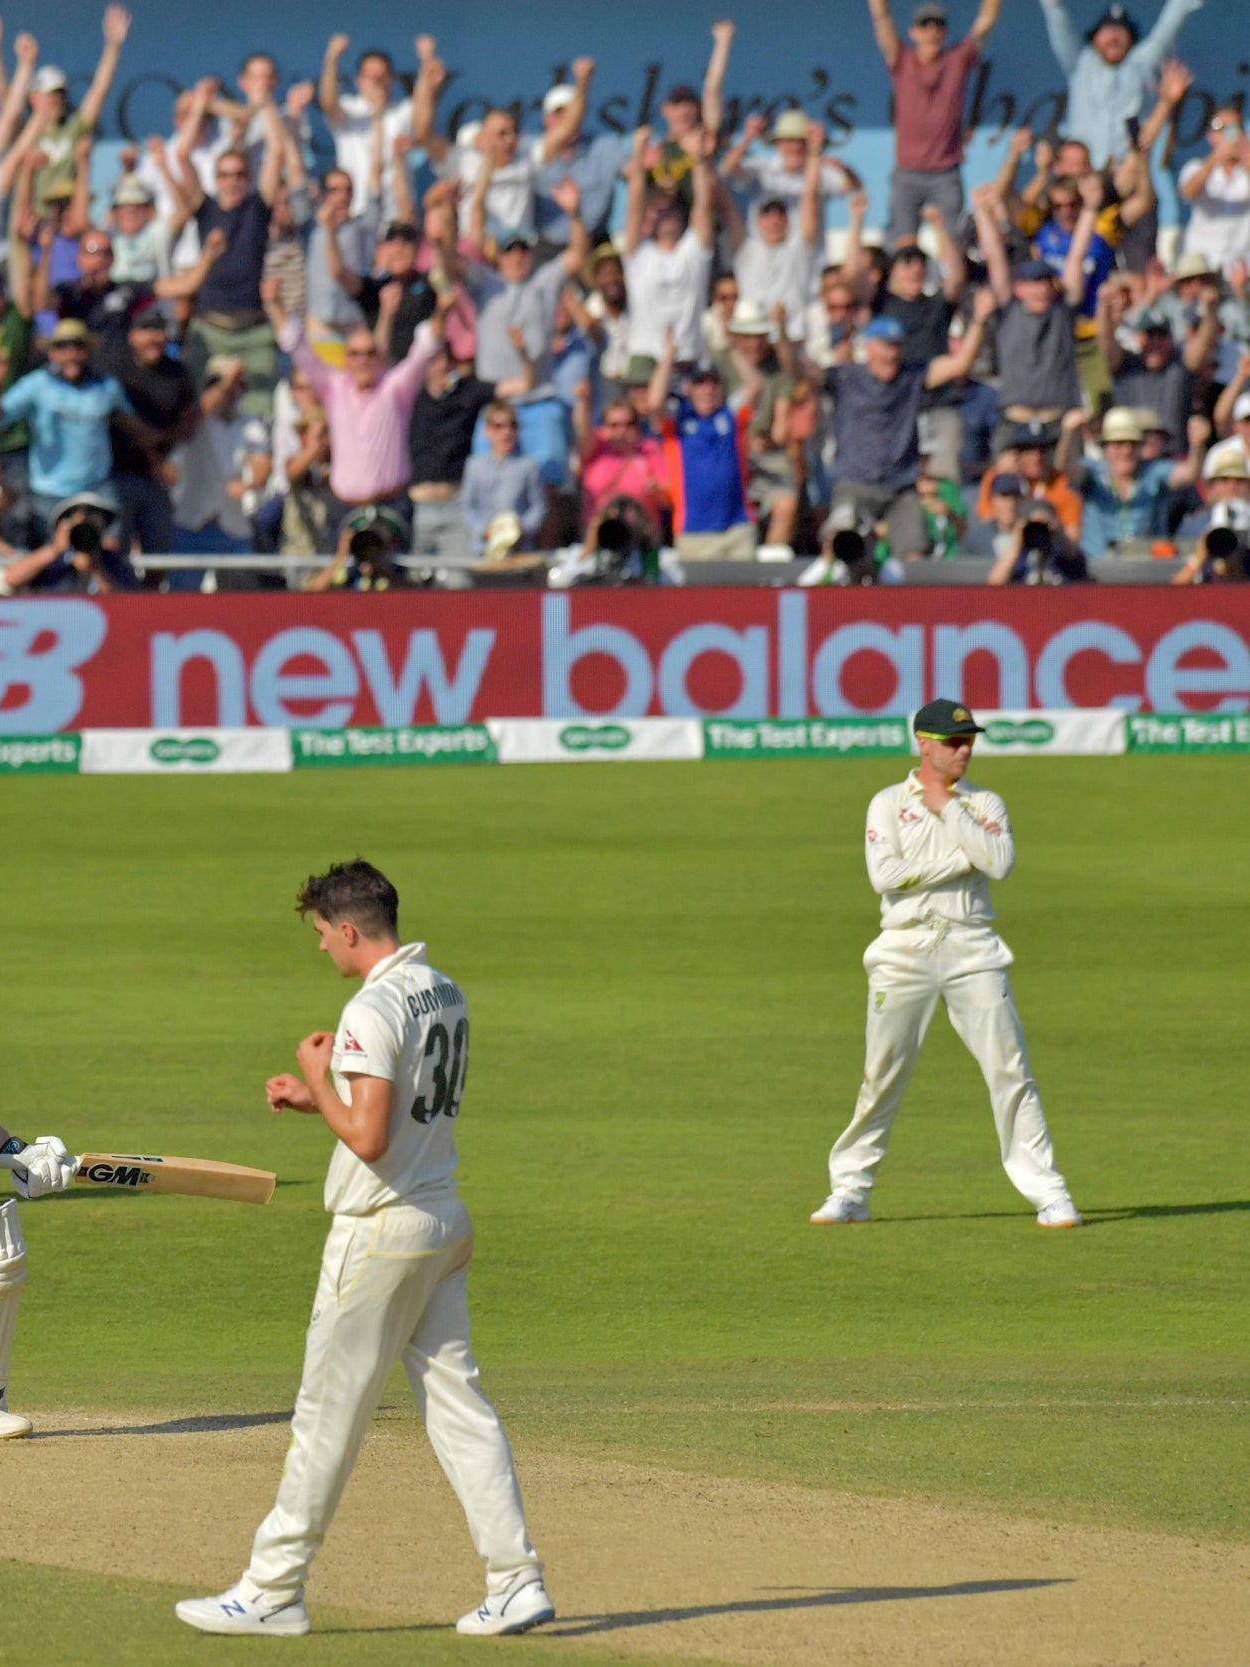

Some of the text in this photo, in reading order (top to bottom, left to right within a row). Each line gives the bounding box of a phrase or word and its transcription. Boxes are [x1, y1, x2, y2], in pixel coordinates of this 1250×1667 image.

[152, 591, 1250, 728] new balance
[300, 729, 488, 758] The Test Experts
[708, 722, 901, 752] The Test Experts
[1132, 719, 1179, 744] The
[1180, 718, 1231, 744] Test
[411, 1017, 469, 1124] 30
[87, 1163, 143, 1187] GM
